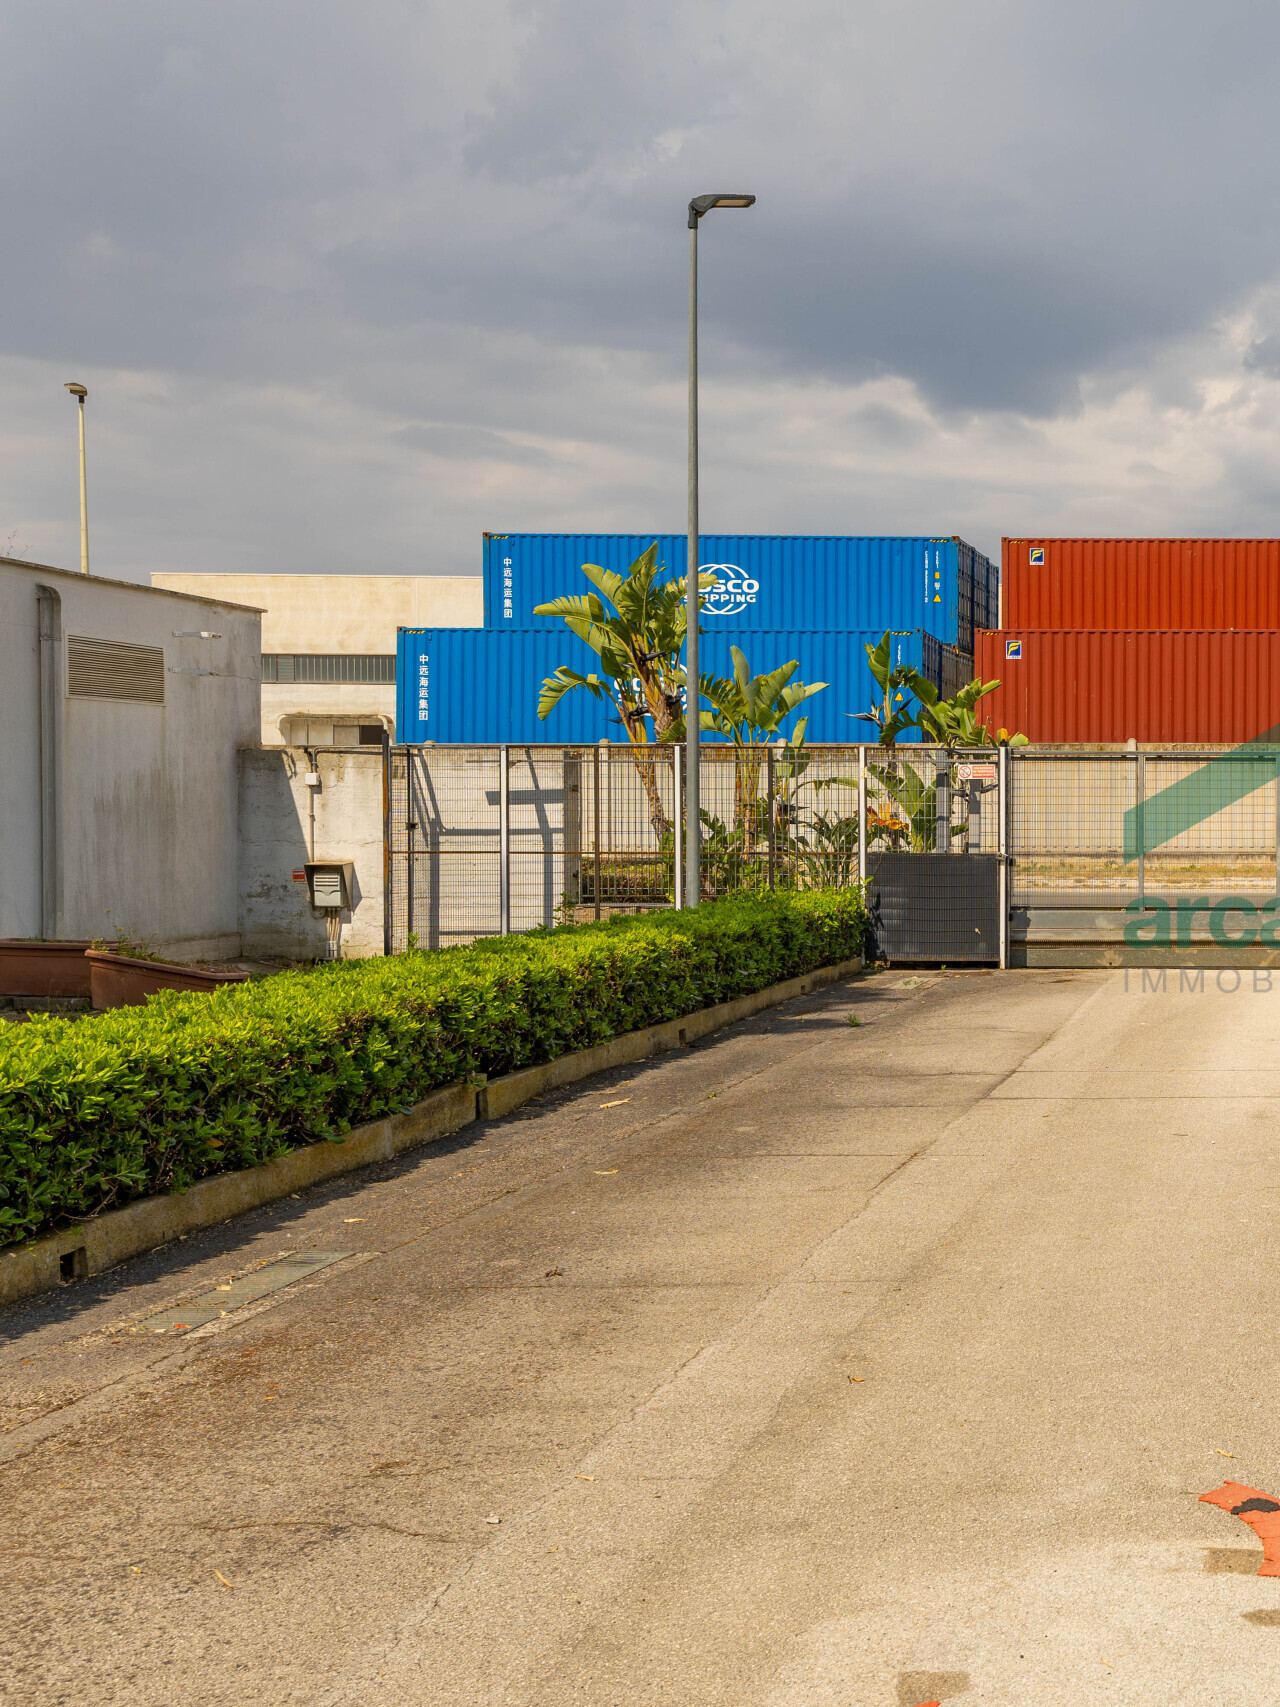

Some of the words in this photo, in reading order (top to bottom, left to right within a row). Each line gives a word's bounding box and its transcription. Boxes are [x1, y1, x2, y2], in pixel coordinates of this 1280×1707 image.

[503, 557, 513, 618] 中远海运集团
[418, 653, 429, 720] 中远海运集团
